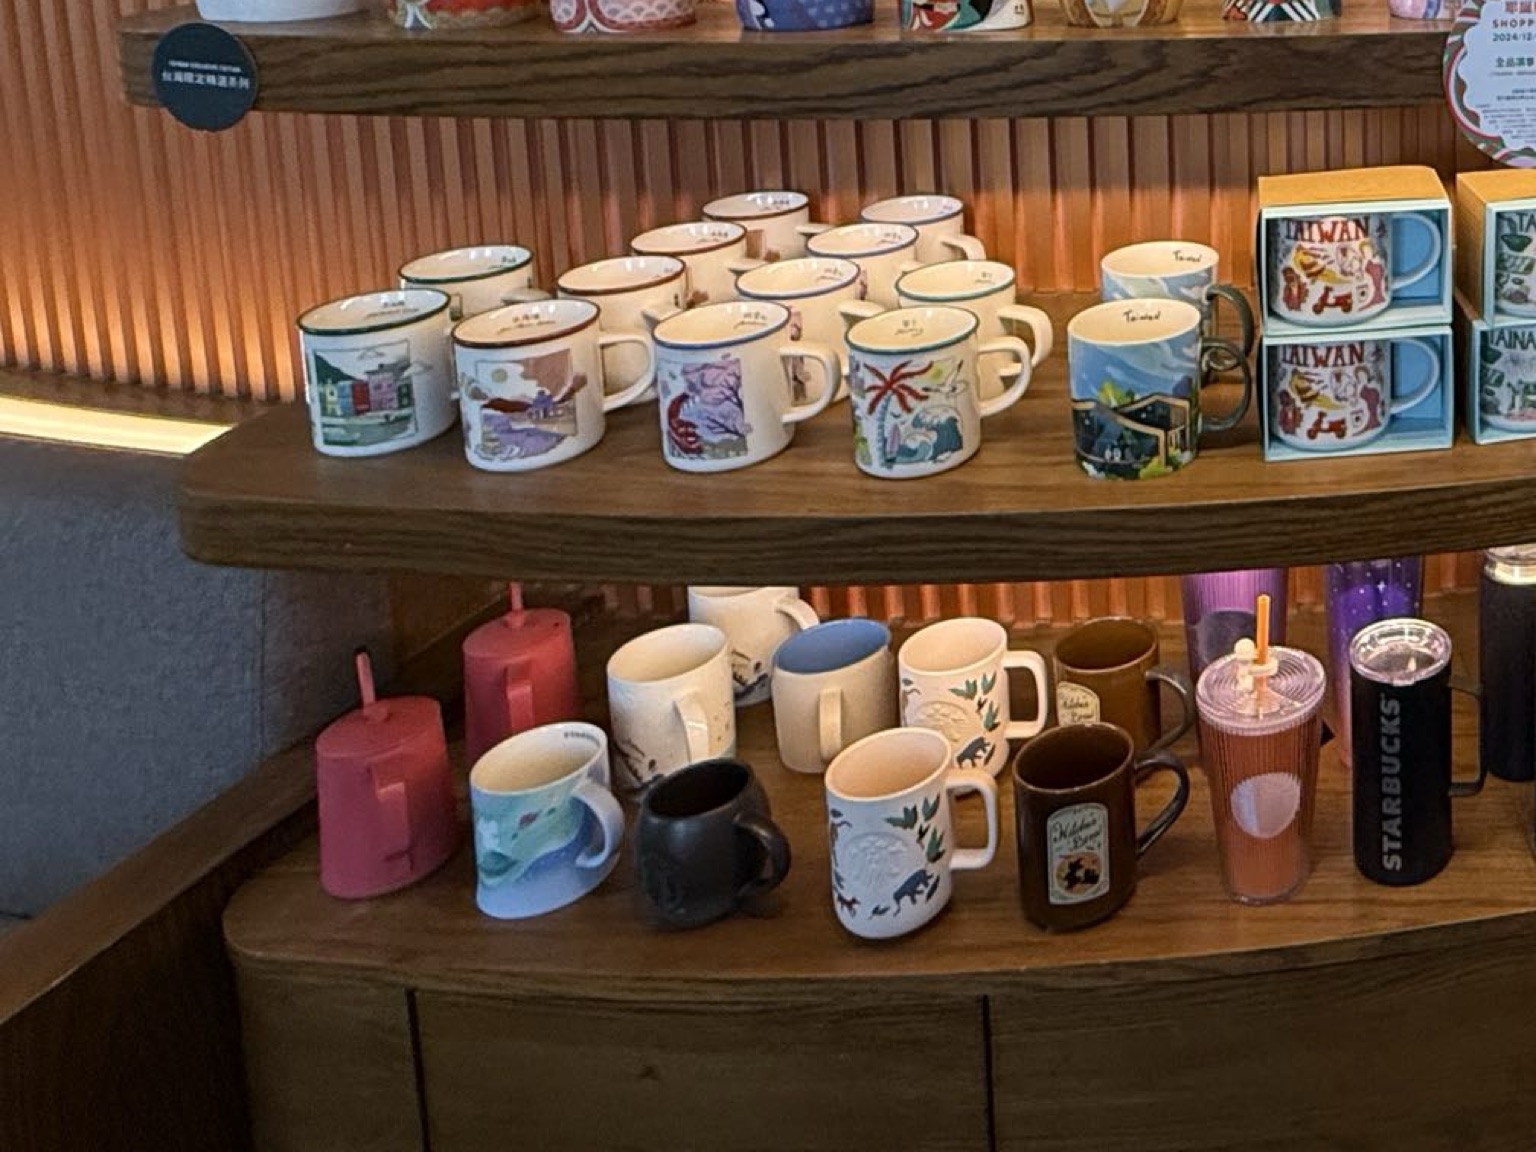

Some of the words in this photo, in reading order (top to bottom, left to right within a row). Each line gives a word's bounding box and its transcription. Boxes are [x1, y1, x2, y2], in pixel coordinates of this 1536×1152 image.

[1284, 217, 1371, 243] TAIWAN
[1282, 341, 1366, 368] TAIWAN
[1380, 694, 1403, 871] STARBUCKS
